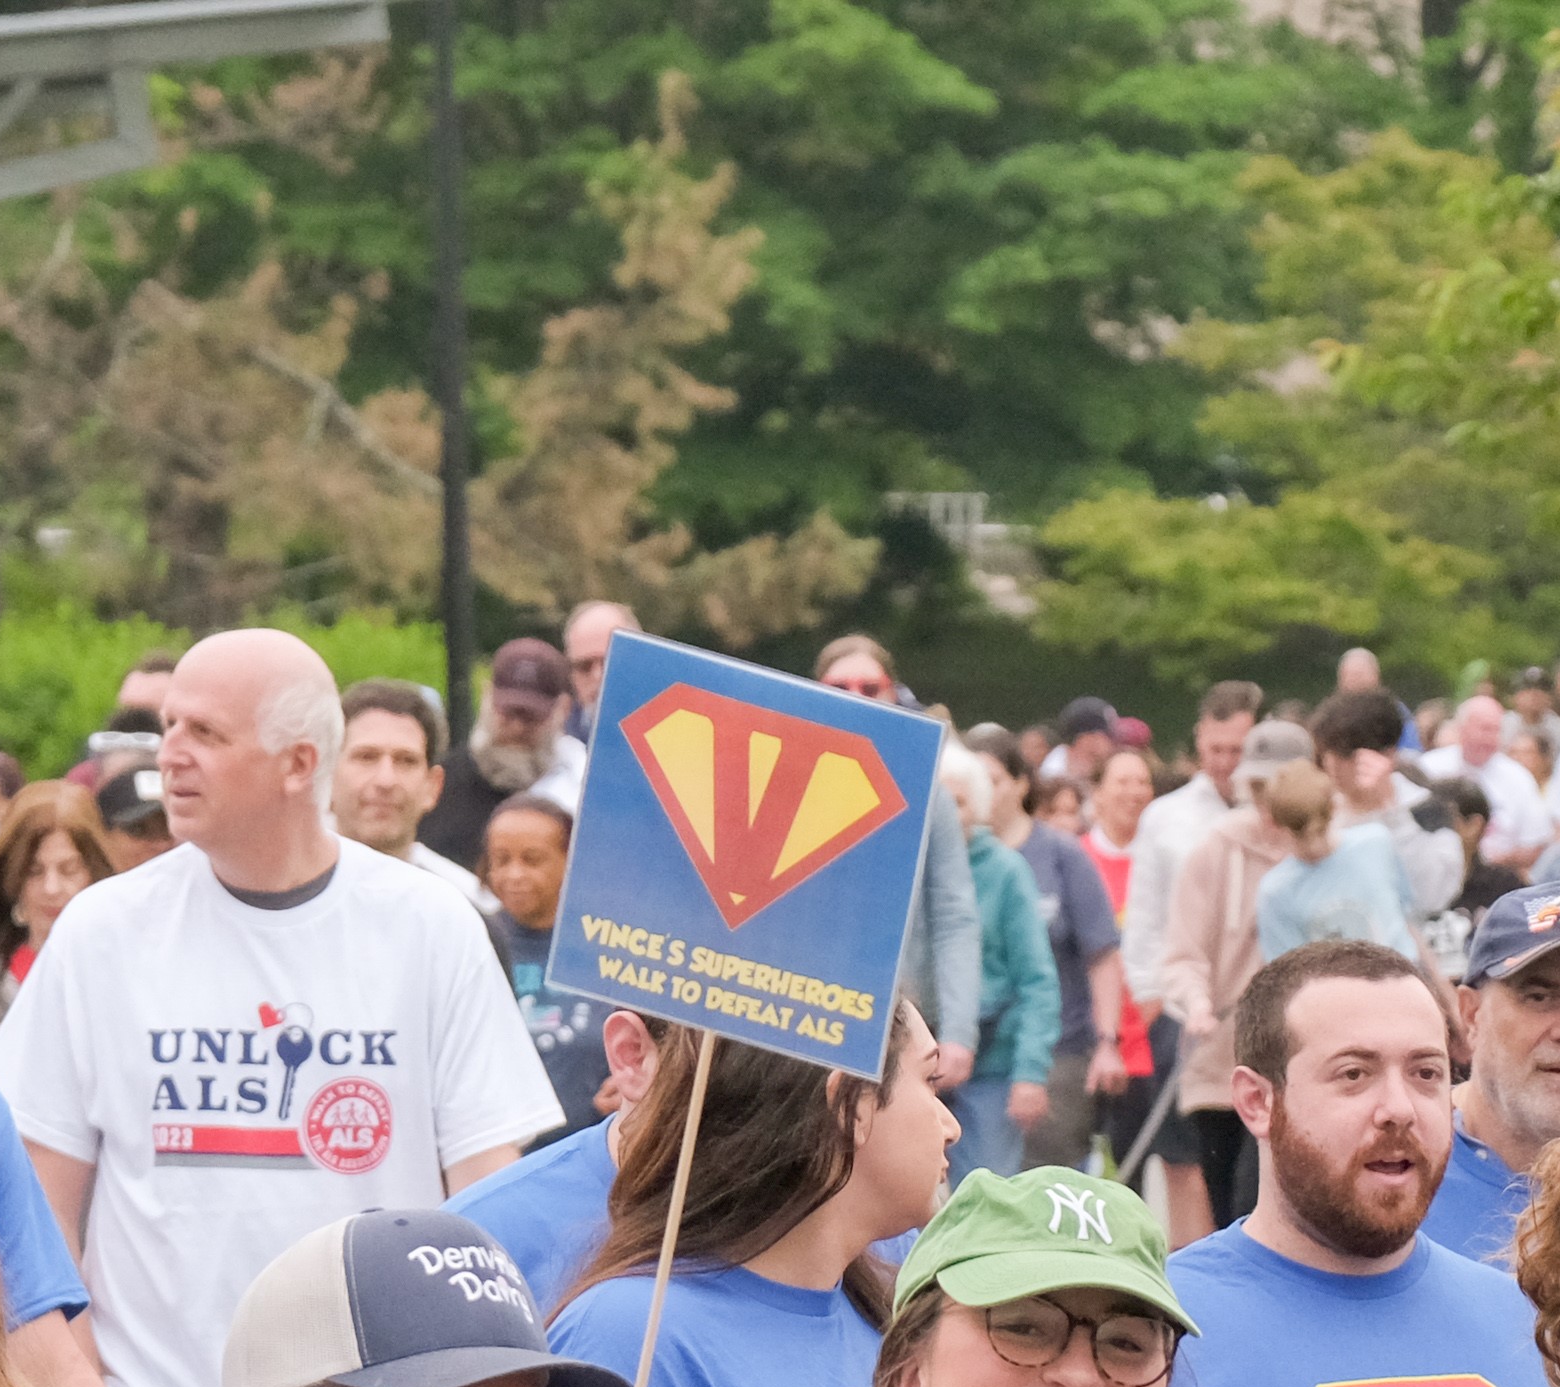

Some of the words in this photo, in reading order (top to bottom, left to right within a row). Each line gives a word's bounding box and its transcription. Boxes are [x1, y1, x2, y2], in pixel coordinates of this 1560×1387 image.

[581, 914, 686, 967] VINCE'S
[689, 946, 875, 1021] SUPERHEROES
[599, 955, 667, 994] WALK
[671, 977, 702, 1004] TO
[705, 986, 794, 1029] DEFEAT
[796, 1013, 845, 1046] ALS
[153, 1075, 268, 1113] ALS
[327, 1127, 374, 1149] ALS
